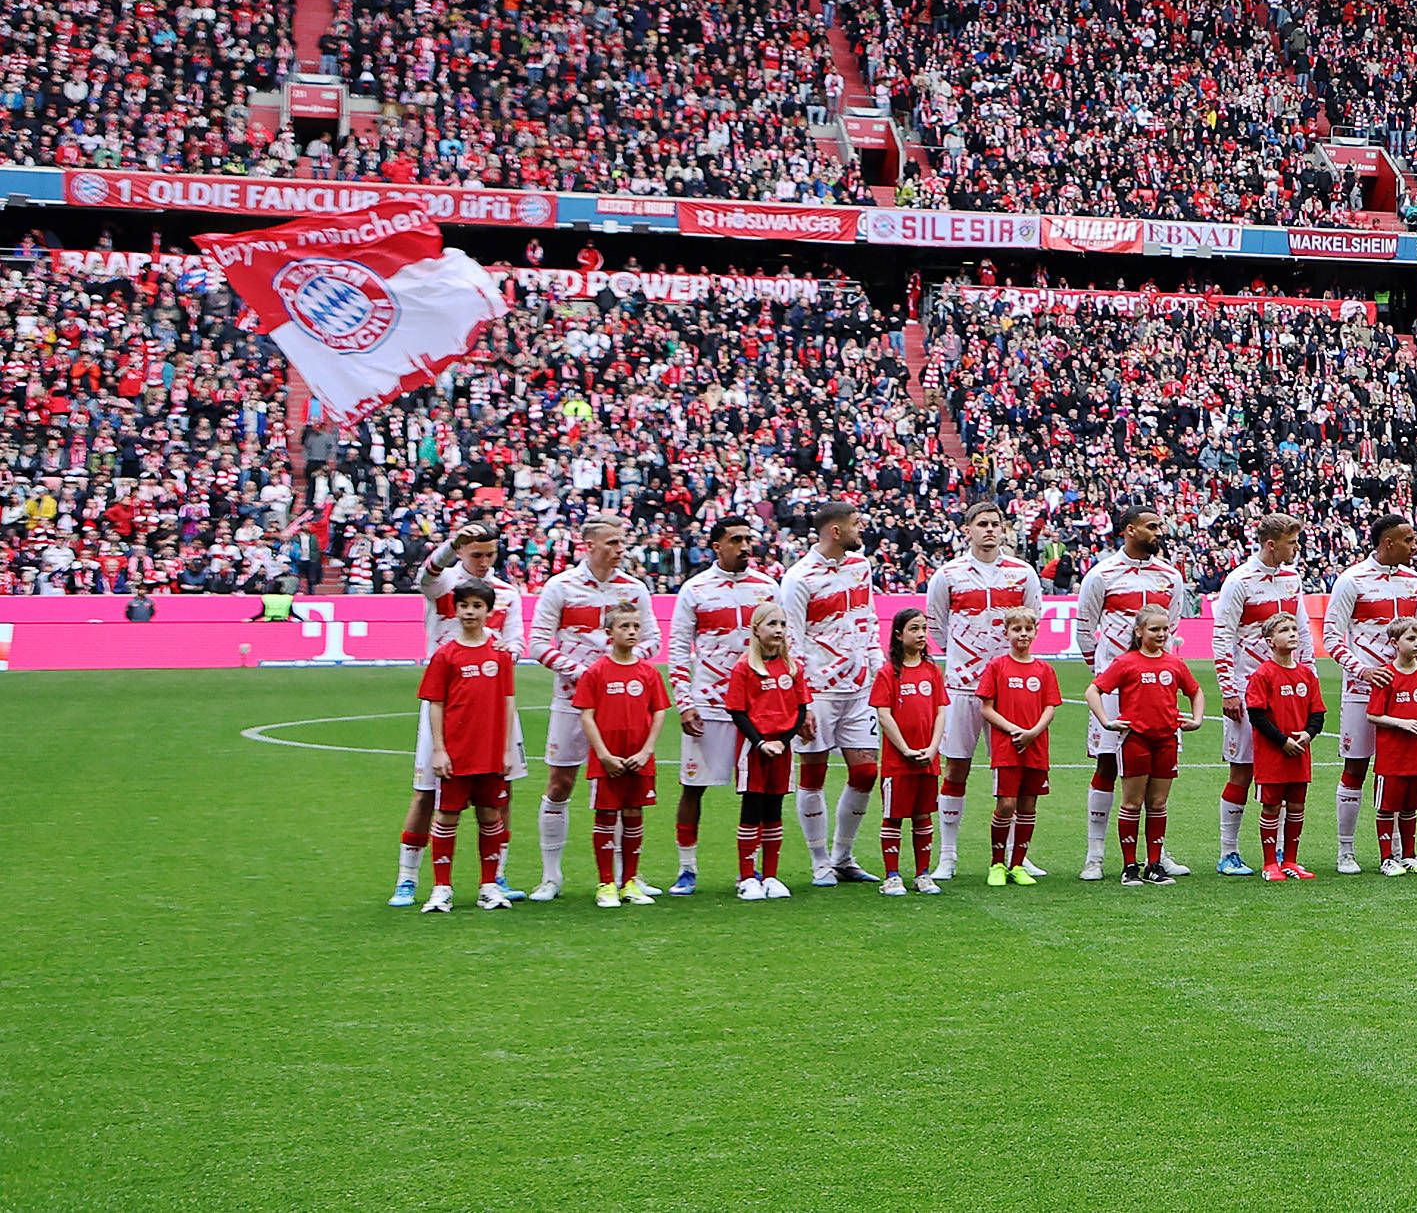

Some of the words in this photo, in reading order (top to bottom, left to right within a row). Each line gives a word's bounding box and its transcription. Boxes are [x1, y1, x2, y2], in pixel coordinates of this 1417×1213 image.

[115, 179, 141, 203] 1.
[149, 180, 241, 208] OLDIE
[902, 216, 1013, 242] SILESIA
[1146, 223, 1239, 248] EBNAT
[1289, 232, 1397, 254] MARKELSHEIM
